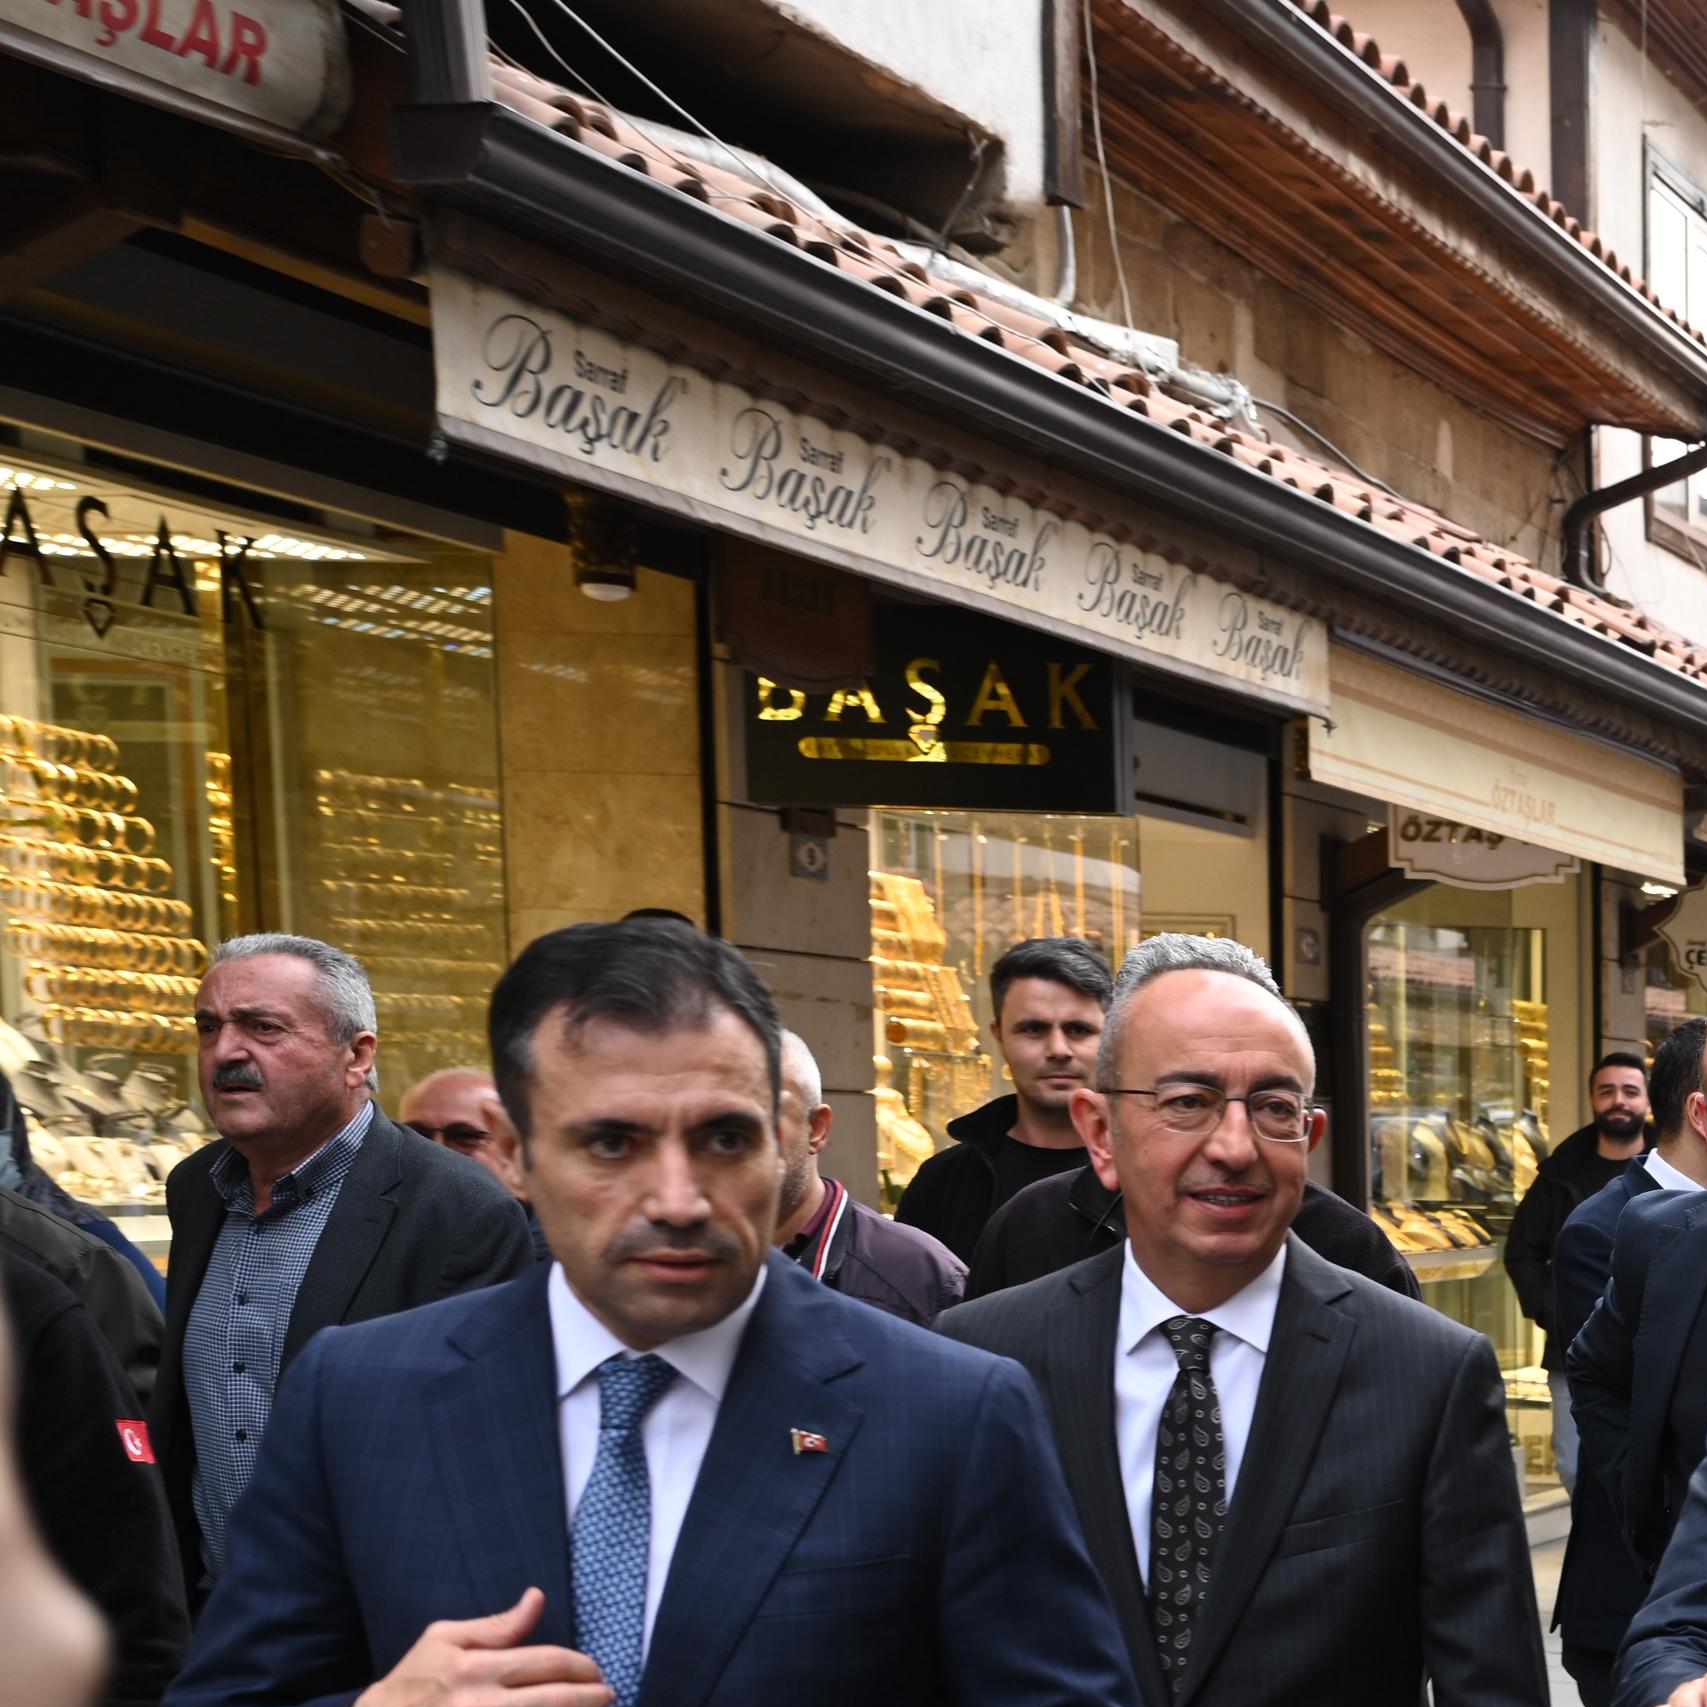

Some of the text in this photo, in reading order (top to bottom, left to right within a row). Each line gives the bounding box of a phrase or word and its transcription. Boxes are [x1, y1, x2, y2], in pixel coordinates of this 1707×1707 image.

[471, 314, 690, 463] Başak
[573, 350, 627, 394] Sarraf
[720, 408, 893, 534] Başak
[916, 480, 1059, 592] Başak
[1077, 542, 1199, 640] Başak
[1211, 591, 1312, 681] Başak
